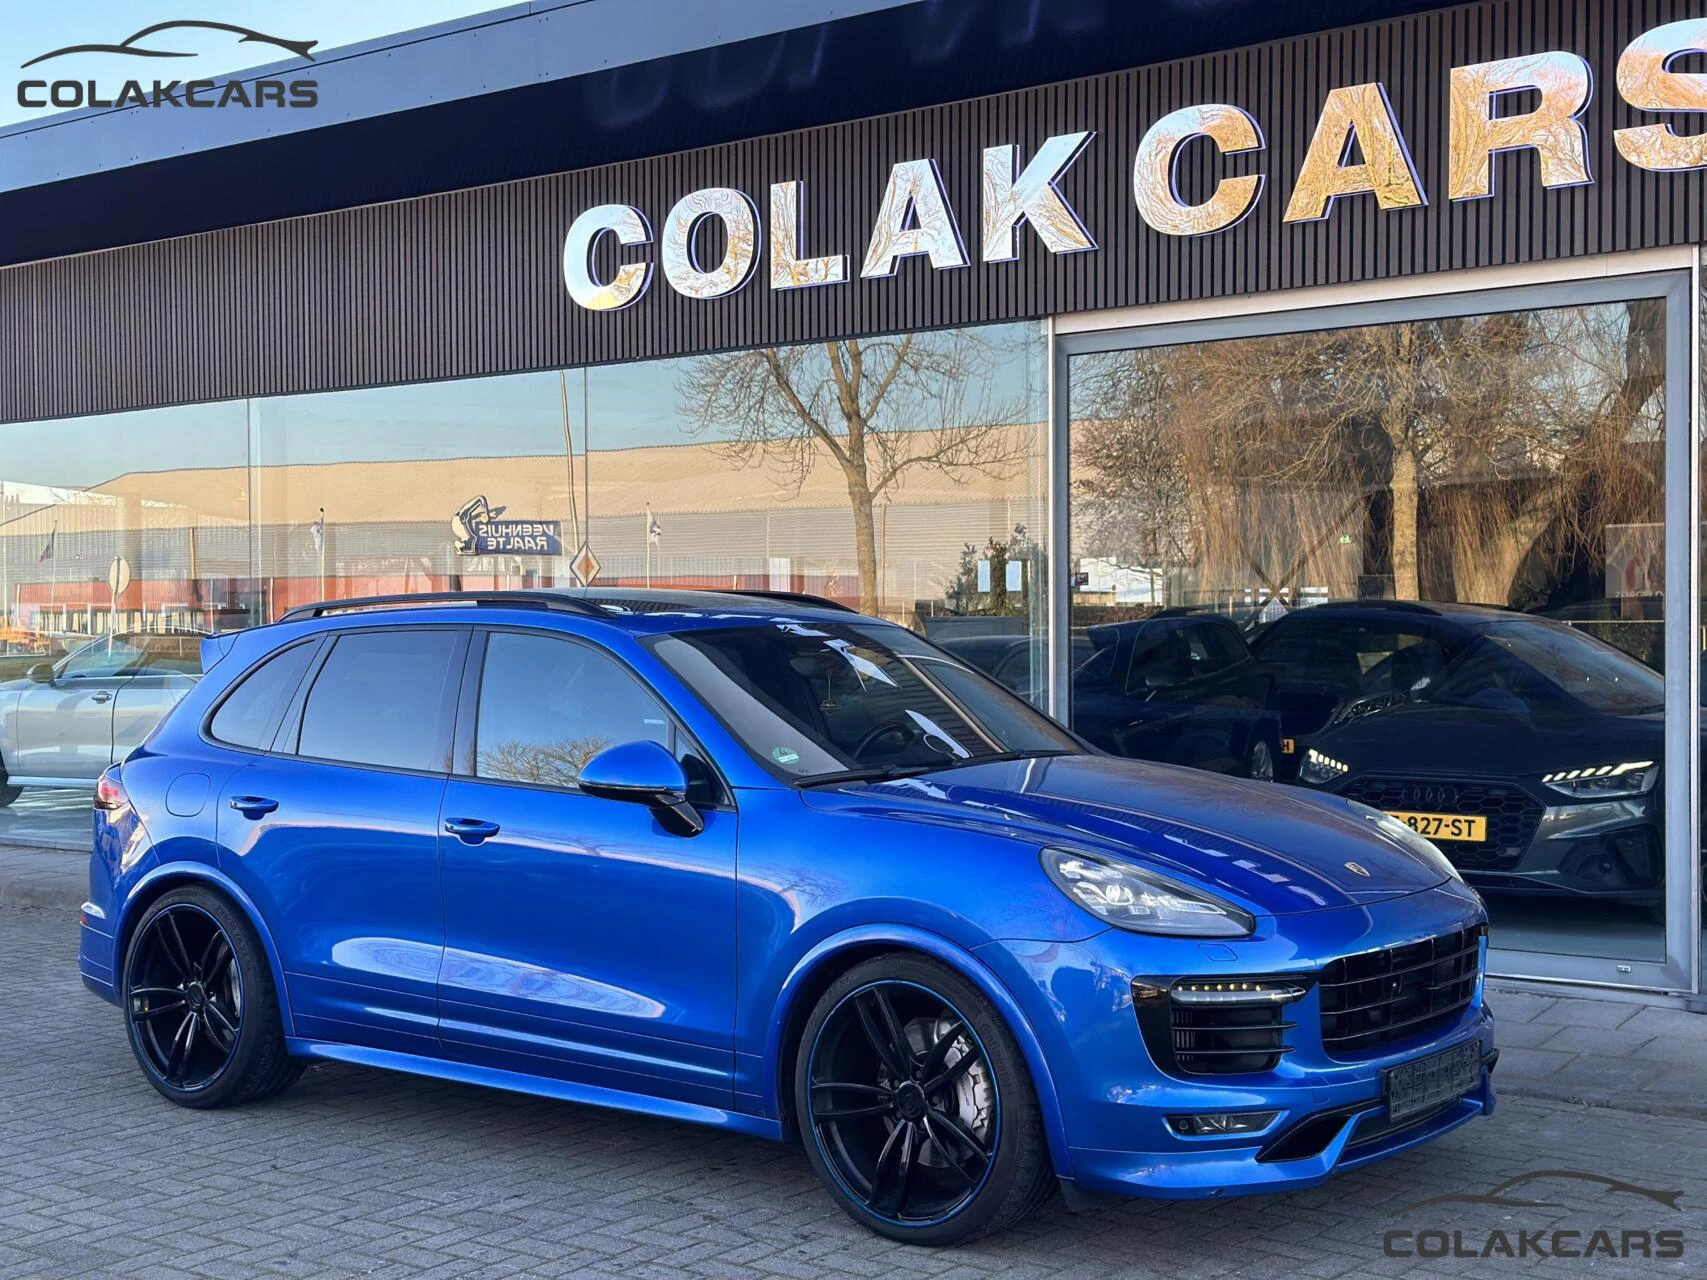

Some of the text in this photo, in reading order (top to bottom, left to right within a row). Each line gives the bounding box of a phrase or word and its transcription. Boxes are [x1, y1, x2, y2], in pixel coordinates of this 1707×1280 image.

[563, 17, 1707, 311] COLAK CARS
[1391, 816, 1476, 838] -827-ST
